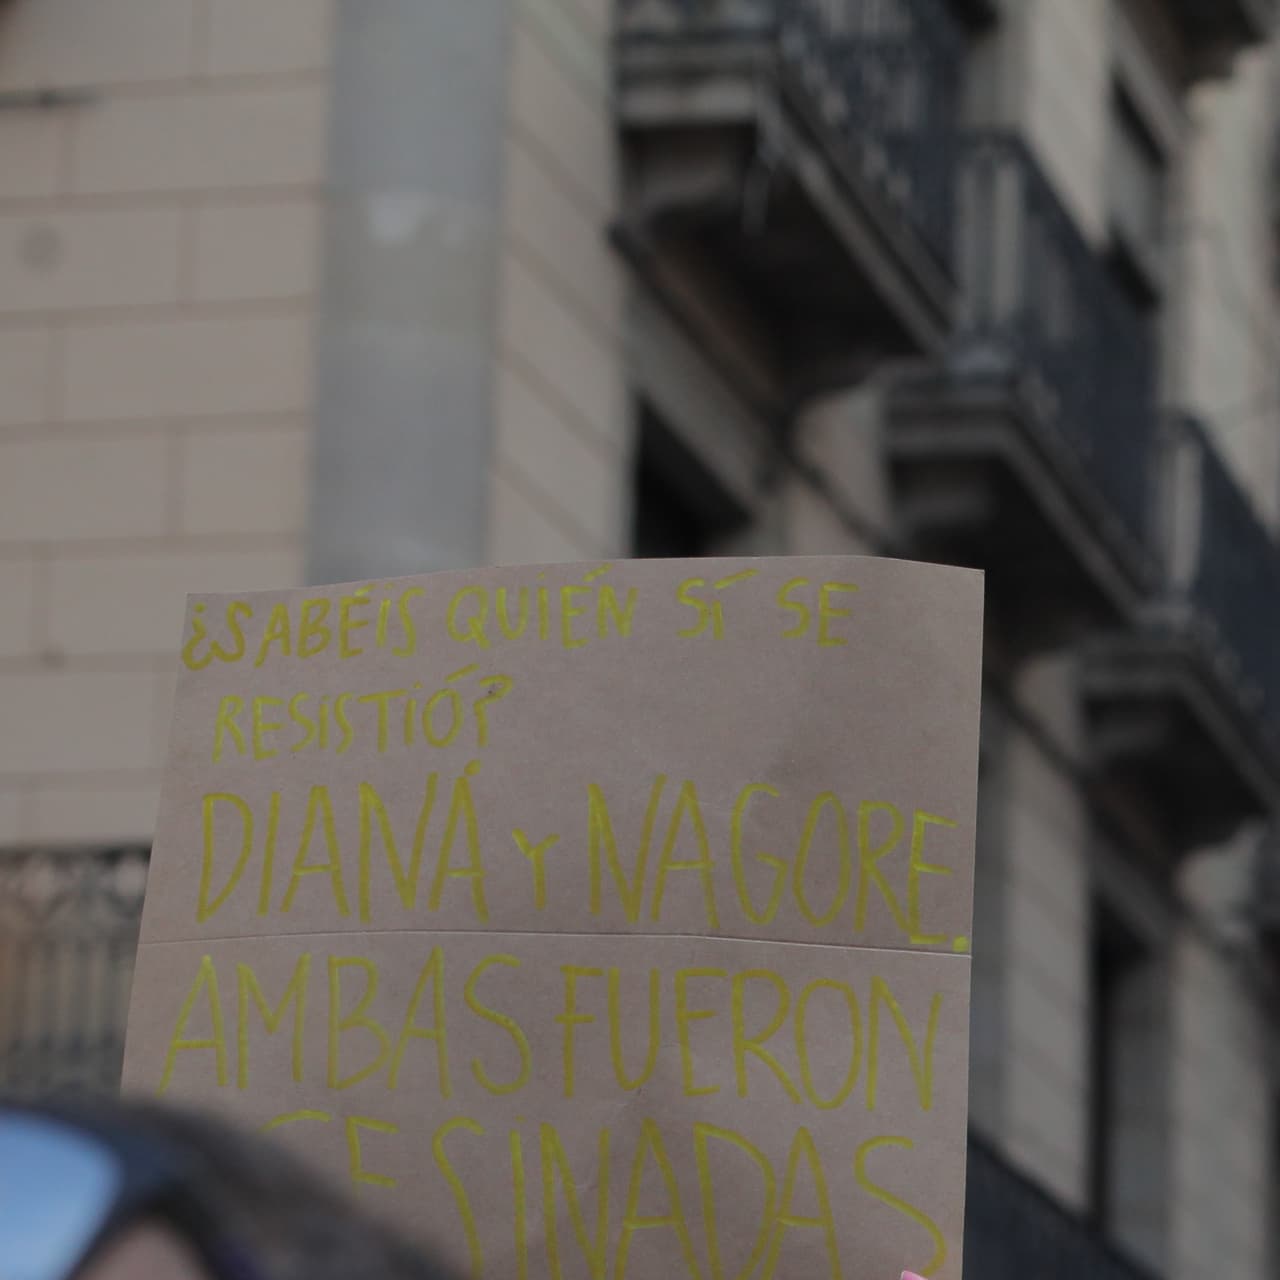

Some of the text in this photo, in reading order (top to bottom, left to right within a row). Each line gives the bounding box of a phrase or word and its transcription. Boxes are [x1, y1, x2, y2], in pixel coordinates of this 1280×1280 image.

[446, 566, 638, 649] QUIÉN
[676, 568, 760, 641] SÍ
[777, 577, 860, 646] SE
[211, 664, 515, 764] RESISTIÓ?
[156, 946, 944, 1113] AMBAS FUERON
